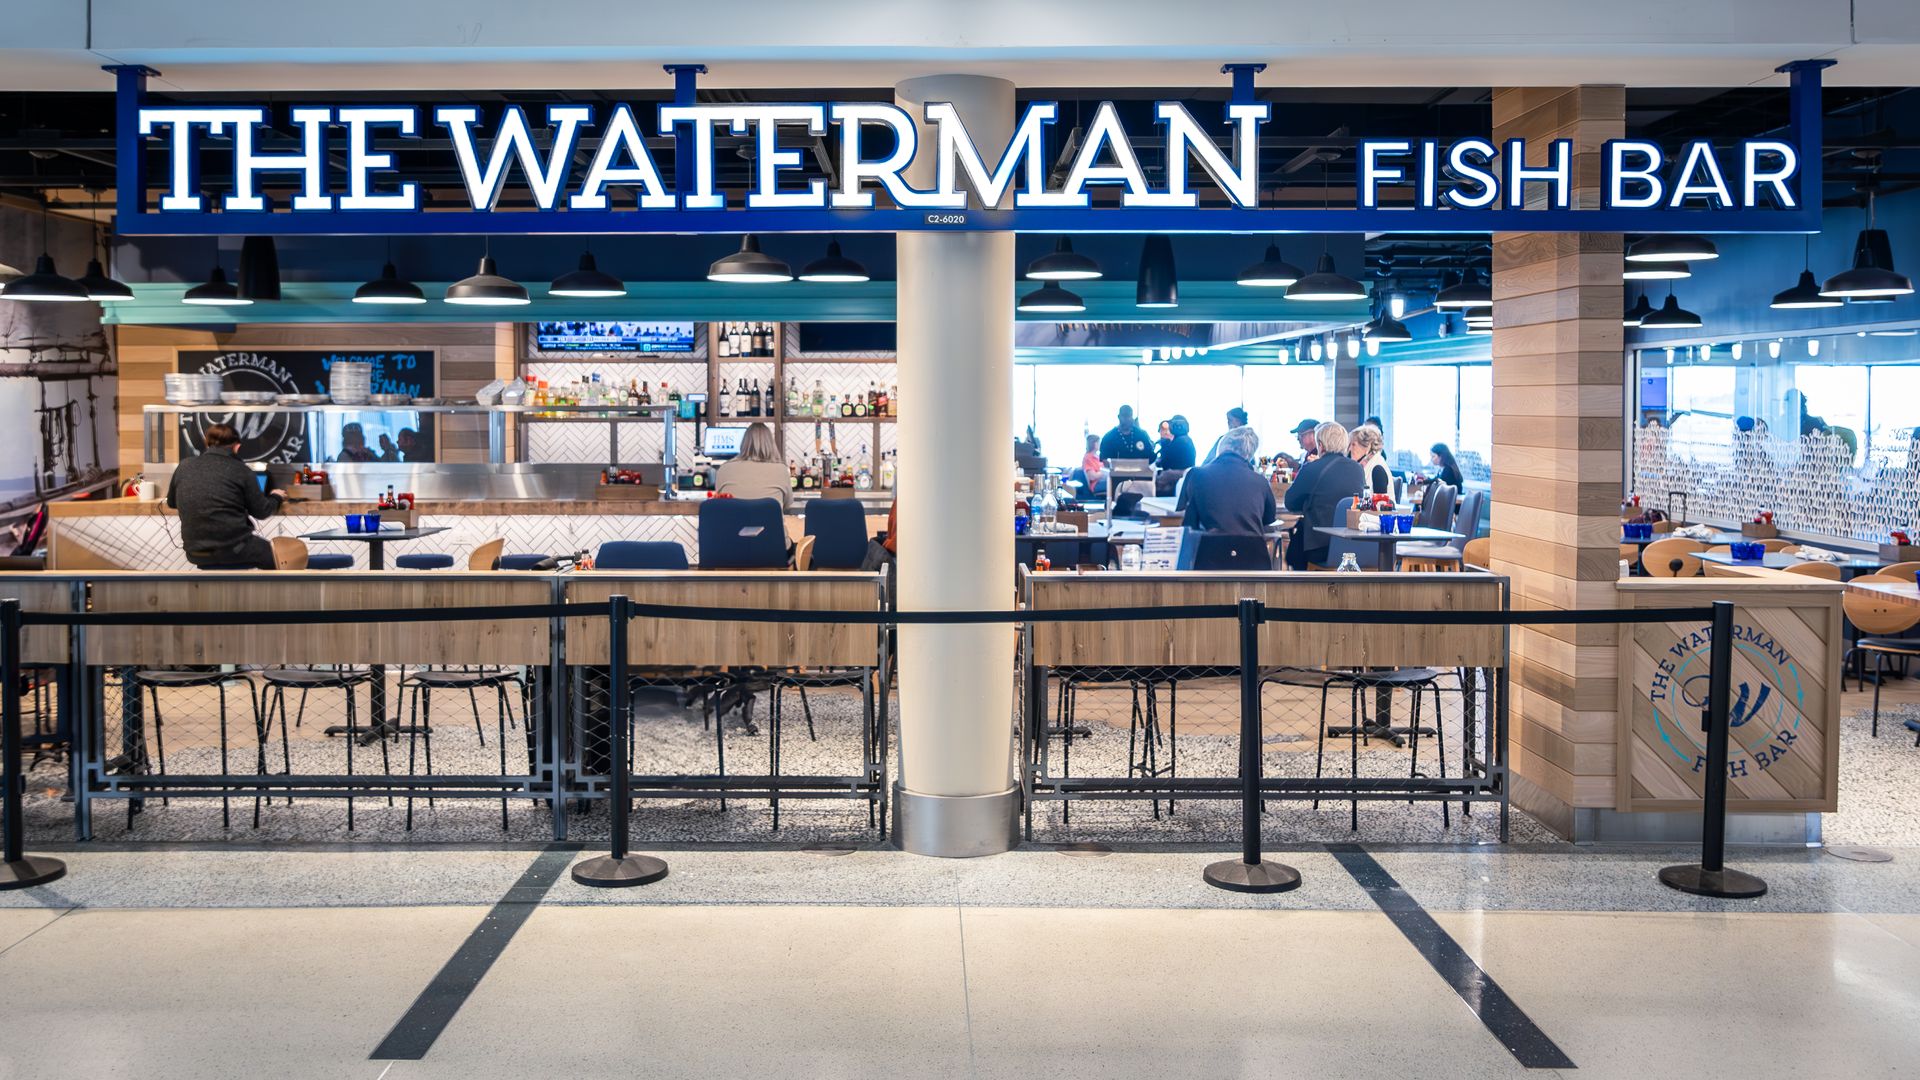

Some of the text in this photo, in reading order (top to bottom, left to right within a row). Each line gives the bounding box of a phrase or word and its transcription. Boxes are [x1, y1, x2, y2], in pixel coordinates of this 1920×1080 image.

[139, 104, 1268, 211] THE WATERMAN
[1363, 141, 1797, 207] FISH BAR
[927, 214, 965, 224] C2-6020
[391, 354, 417, 370] TO
[1651, 624, 1790, 702] THE WATRMAN
[1692, 729, 1798, 779] FH BAR
